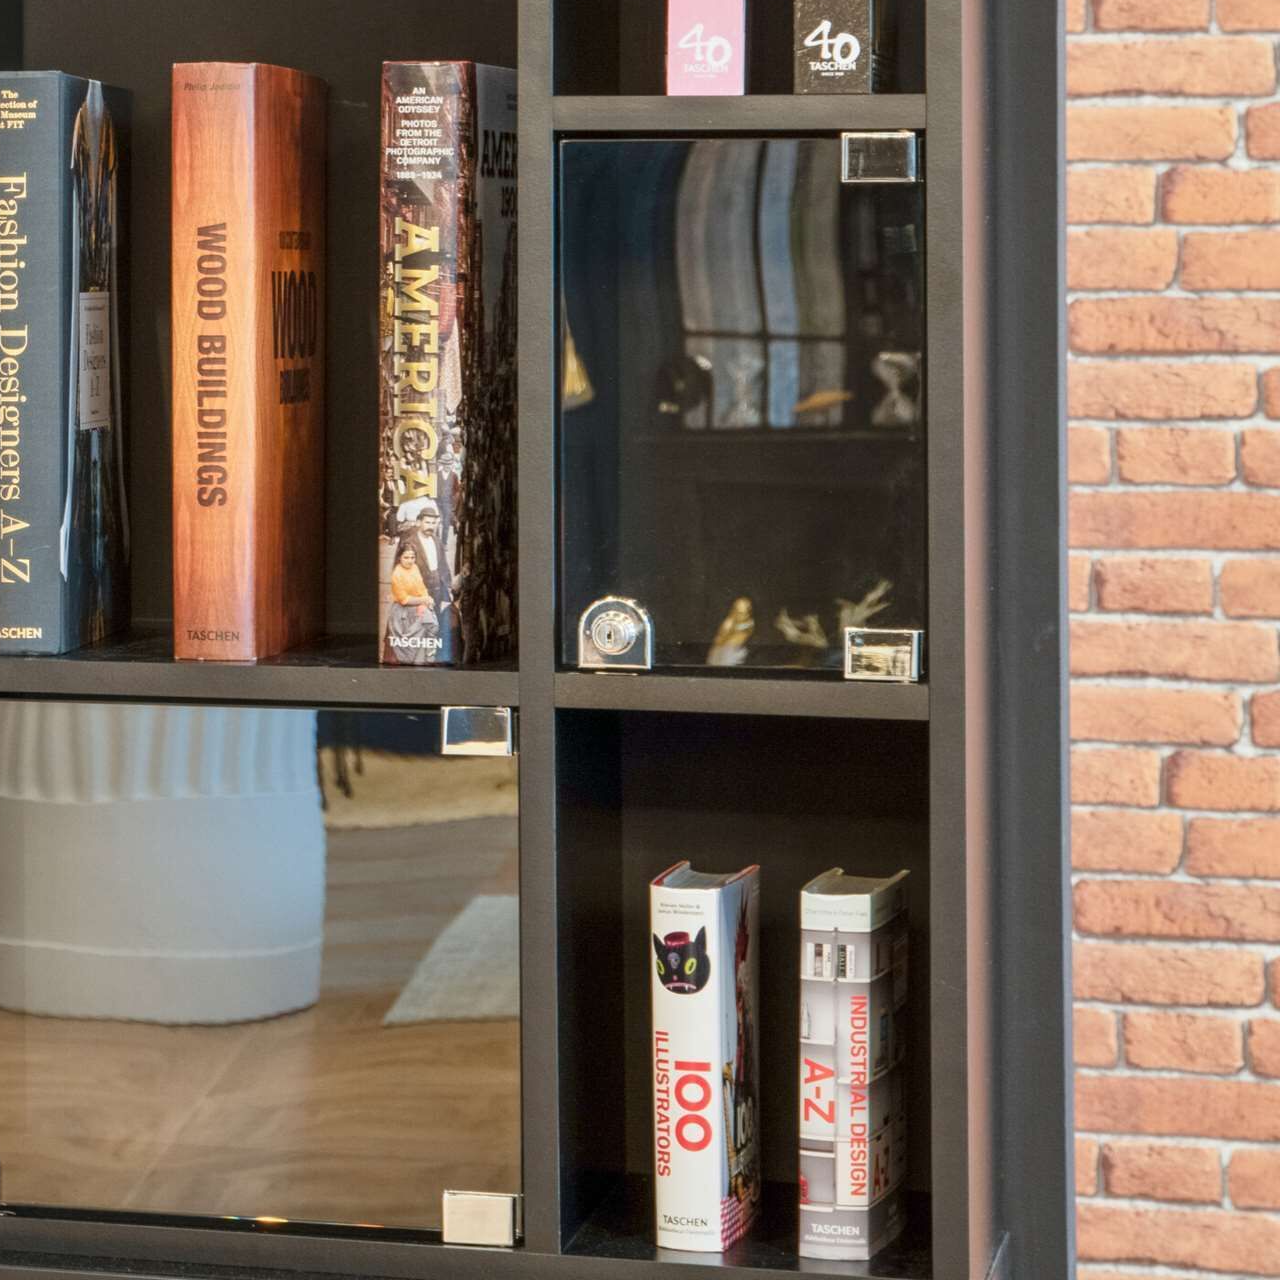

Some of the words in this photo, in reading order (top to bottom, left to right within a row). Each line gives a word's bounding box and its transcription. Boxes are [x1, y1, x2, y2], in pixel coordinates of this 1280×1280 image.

[677, 23, 733, 67] 40
[803, 20, 861, 65] 40
[808, 61, 857, 71] TASCHEN
[0, 89, 19, 99] The
[412, 87, 426, 95] AN
[27, 99, 38, 109] of
[395, 96, 443, 104] AMERICAN
[0, 110, 37, 119] Museum
[398, 105, 440, 114] ODYSSEY
[401, 119, 438, 128] PHOTOS
[395, 128, 422, 137] FROM
[425, 128, 443, 137] THE
[399, 138, 438, 146] DETROIT
[384, 147, 455, 156] PHOTOGRAPHIC
[396, 156, 442, 165] COMPANY
[196, 222, 227, 321] WOOD
[393, 215, 440, 507] AMERICA
[196, 334, 227, 508] BUILDINGS
[186, 629, 240, 641] TASCHEN
[387, 635, 443, 649] TASCHEN
[849, 995, 868, 1117] INDUSTRIAL
[803, 1057, 836, 1125] A-Z
[654, 1030, 672, 1177] ILLUSTRATORS
[849, 1123, 868, 1197] DESIGN
[662, 1214, 708, 1227] TASCHEN
[811, 1223, 861, 1236] TASCHEN
